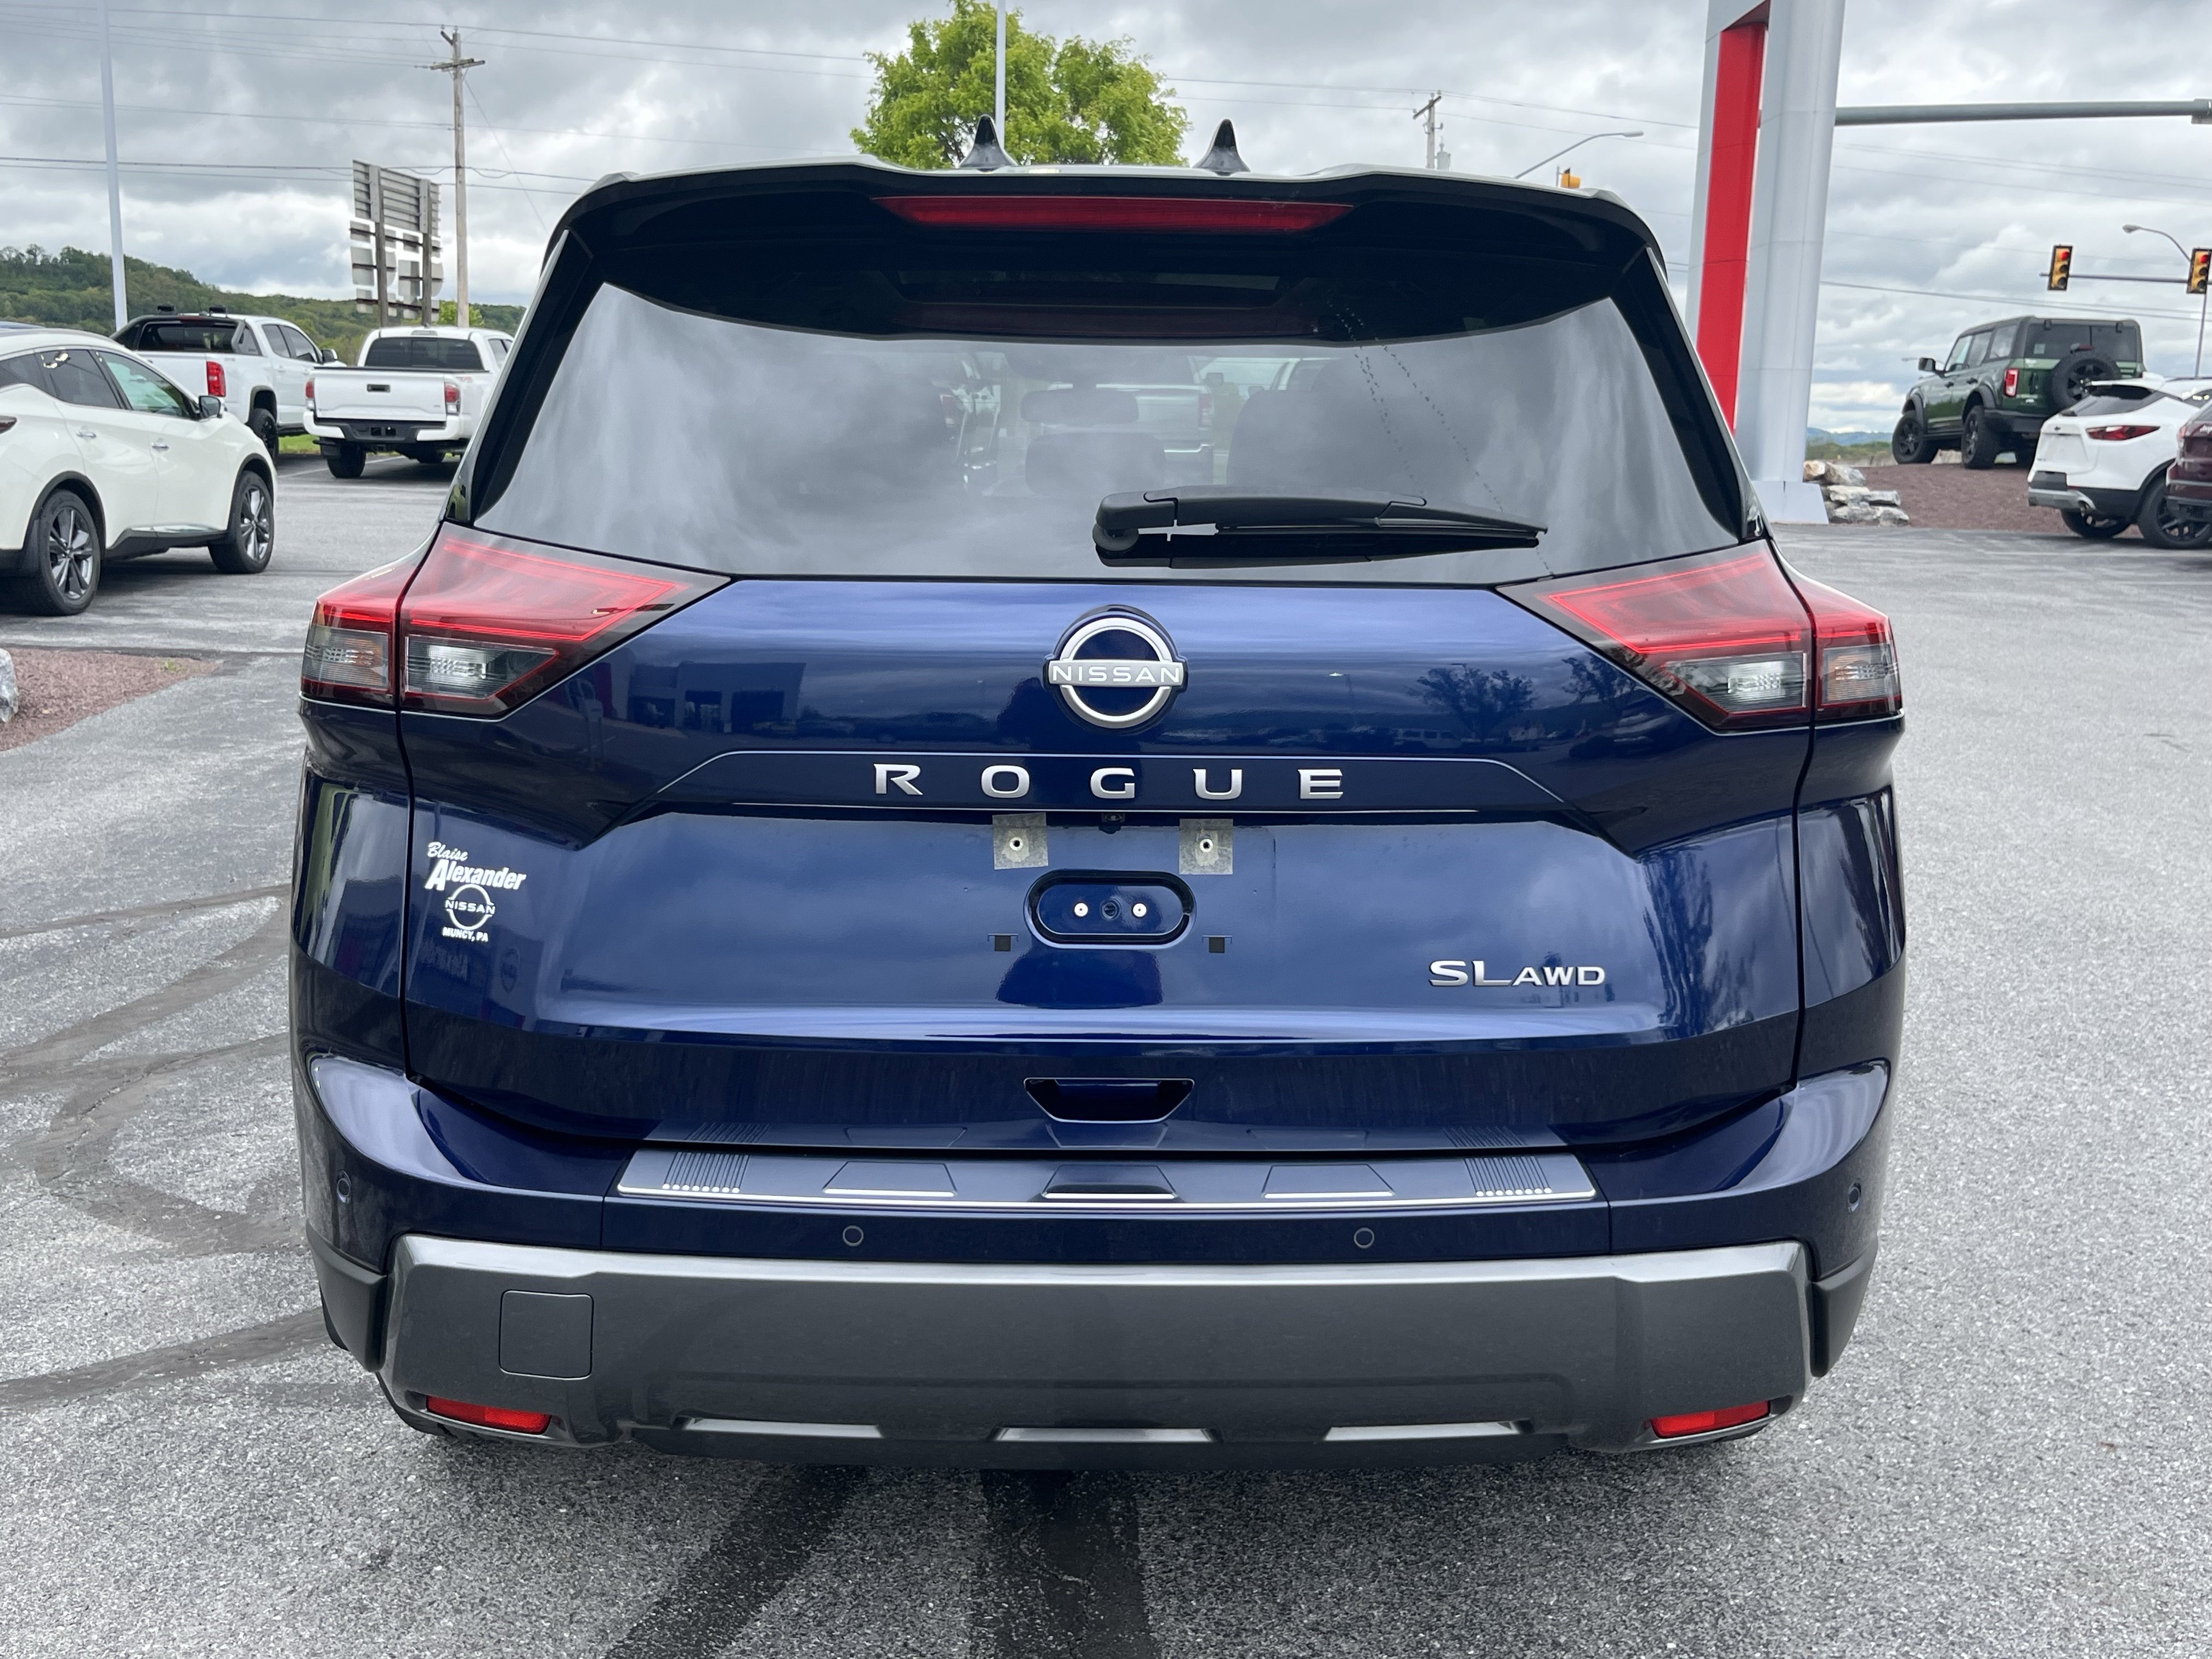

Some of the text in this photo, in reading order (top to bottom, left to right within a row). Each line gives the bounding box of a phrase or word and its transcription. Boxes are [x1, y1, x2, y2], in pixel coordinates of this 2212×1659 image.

[1052, 665, 1180, 682] NISSAN
[873, 764, 1344, 800] ROGUE
[427, 842, 468, 861] Blaise
[425, 859, 527, 891] Alexander
[445, 900, 495, 915] NISSAN
[476, 932, 488, 942] PA
